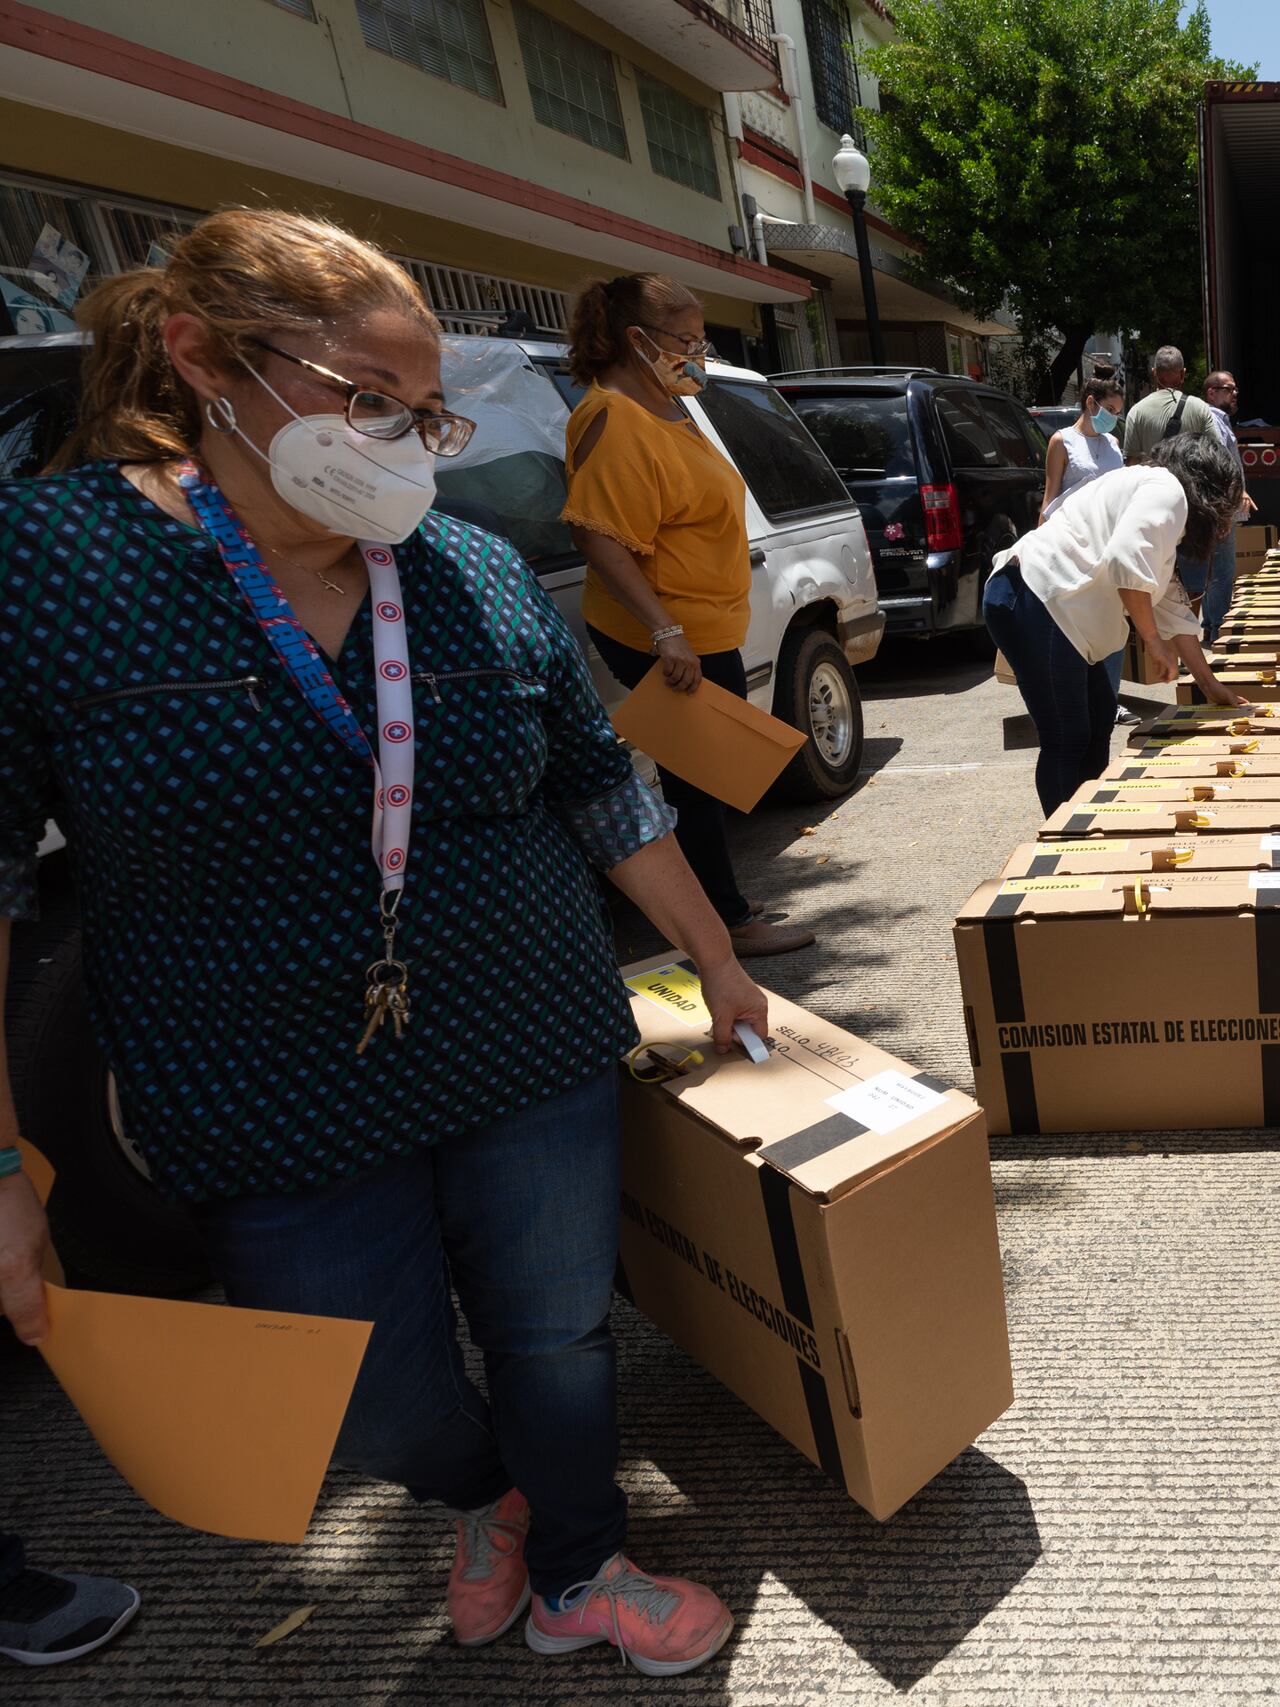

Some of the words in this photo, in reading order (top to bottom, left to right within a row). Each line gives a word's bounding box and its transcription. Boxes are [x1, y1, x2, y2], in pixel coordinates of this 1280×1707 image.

[189, 486, 283, 618] CAPTAIN
[265, 624, 371, 757] AMERICA
[1056, 846, 1107, 854] UNIDAD
[1024, 883, 1081, 892] UNIDAD
[647, 982, 697, 1012] UNIDAD
[775, 1025, 810, 1045] SELLO
[998, 1022, 1087, 1049] COMISION
[1092, 1020, 1159, 1046] ESTATAL
[1164, 1019, 1185, 1043] DE
[645, 1208, 704, 1276] ESTATAL
[703, 1251, 725, 1293] DE
[724, 1268, 822, 1369] ELECCIONES
